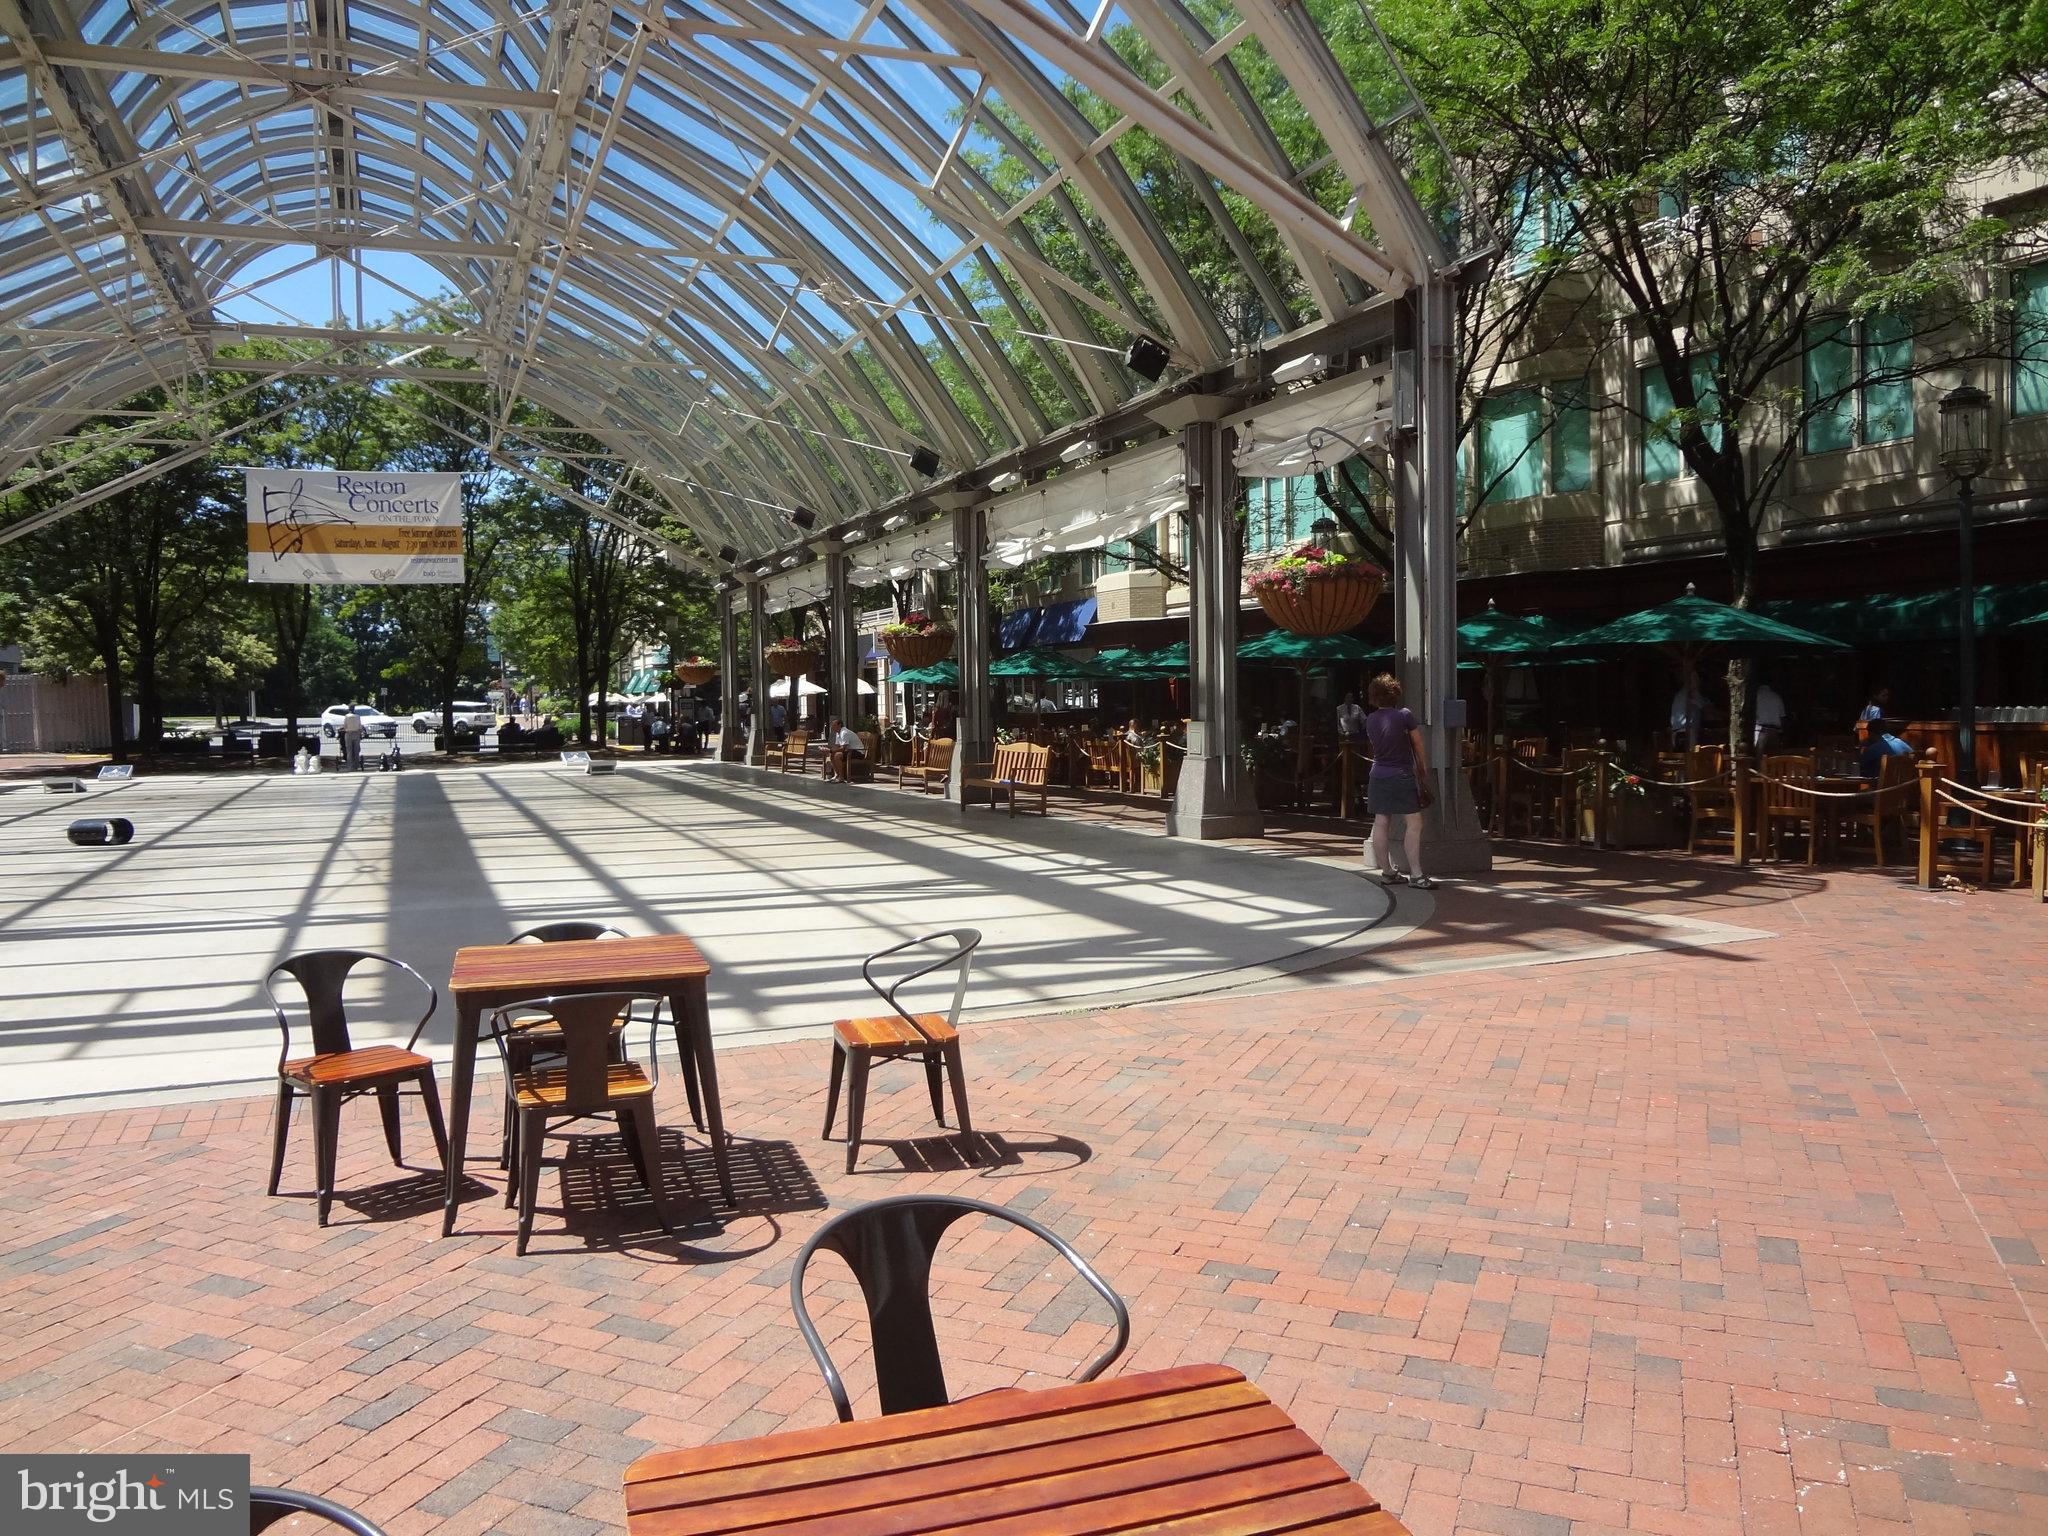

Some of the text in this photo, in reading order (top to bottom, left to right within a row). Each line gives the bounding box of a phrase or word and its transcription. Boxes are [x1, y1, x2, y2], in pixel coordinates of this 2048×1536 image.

[336, 475, 406, 495] Reston
[349, 493, 439, 514] Concerts
[378, 515, 439, 523] ON THE TOWN
